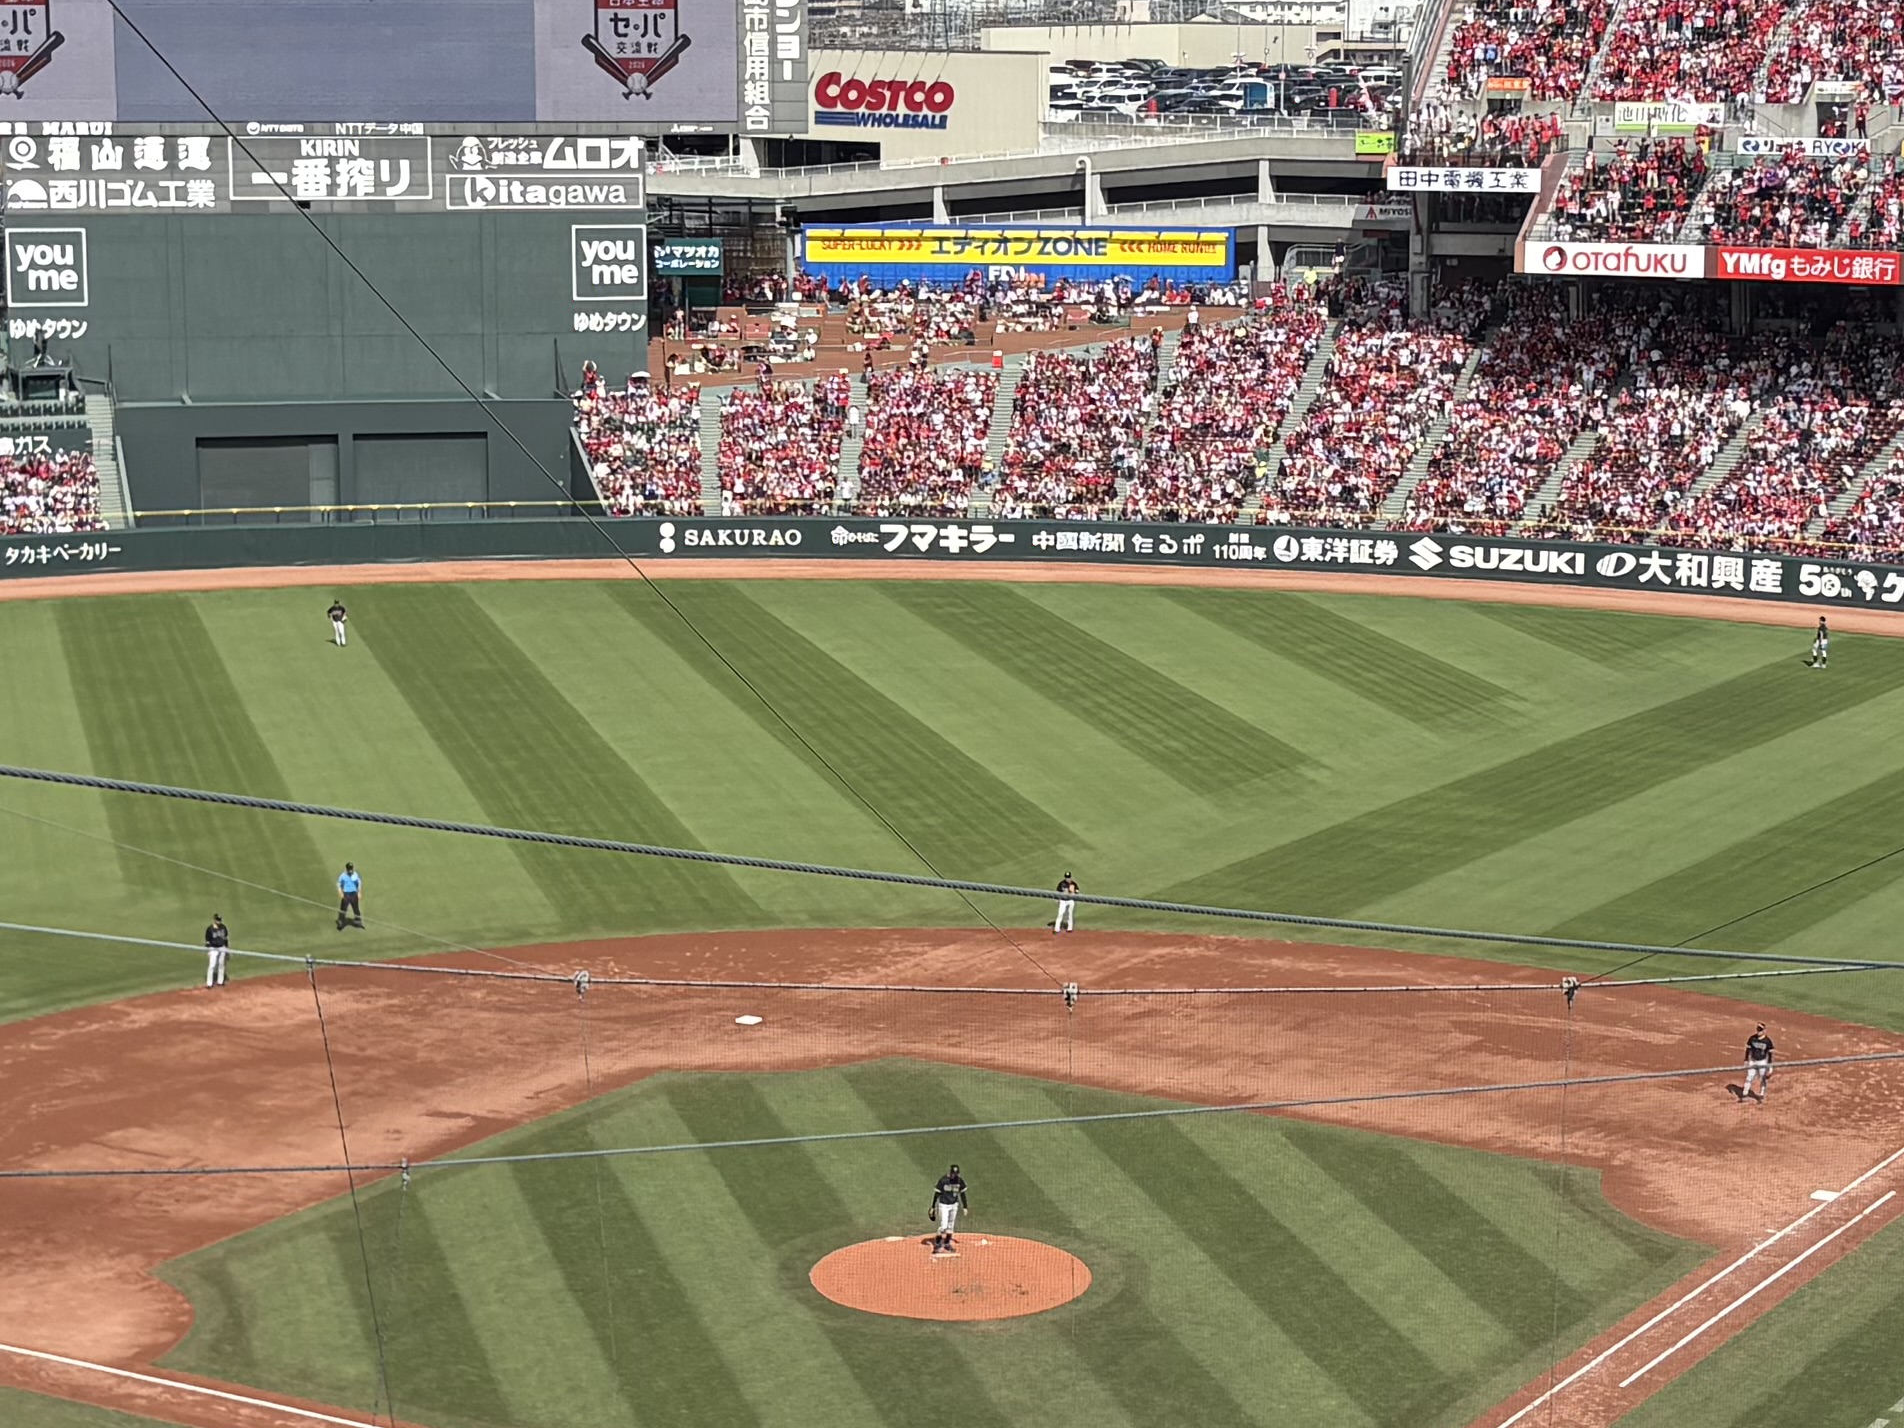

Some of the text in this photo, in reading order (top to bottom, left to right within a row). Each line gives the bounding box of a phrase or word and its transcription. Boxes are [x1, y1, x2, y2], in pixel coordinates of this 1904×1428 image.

[814, 71, 955, 113] COSTCO
[855, 112, 948, 130] WHOLESALE
[300, 139, 360, 158] KIRIN
[543, 137, 645, 170] ムロオ
[251, 158, 411, 199] 一番搾り
[49, 178, 216, 210] 西川ゴム工業
[15, 244, 74, 272] you
[580, 238, 636, 267] you
[1721, 252, 1897, 281] YMfg もみじ銀行
[27, 268, 79, 291] me
[591, 264, 639, 286] me
[9, 318, 88, 340] ゆめタウン
[573, 312, 647, 334] ゆめタウン
[684, 528, 803, 547] SAKURAO
[880, 523, 1015, 554] フマキラー
[1300, 535, 1399, 566] 東洋証券
[4, 541, 122, 566] タカキベーカリー
[1212, 544, 1268, 562] 110周年
[1449, 545, 1586, 576] SUZUKI
[1637, 549, 1784, 595] 大和興産
